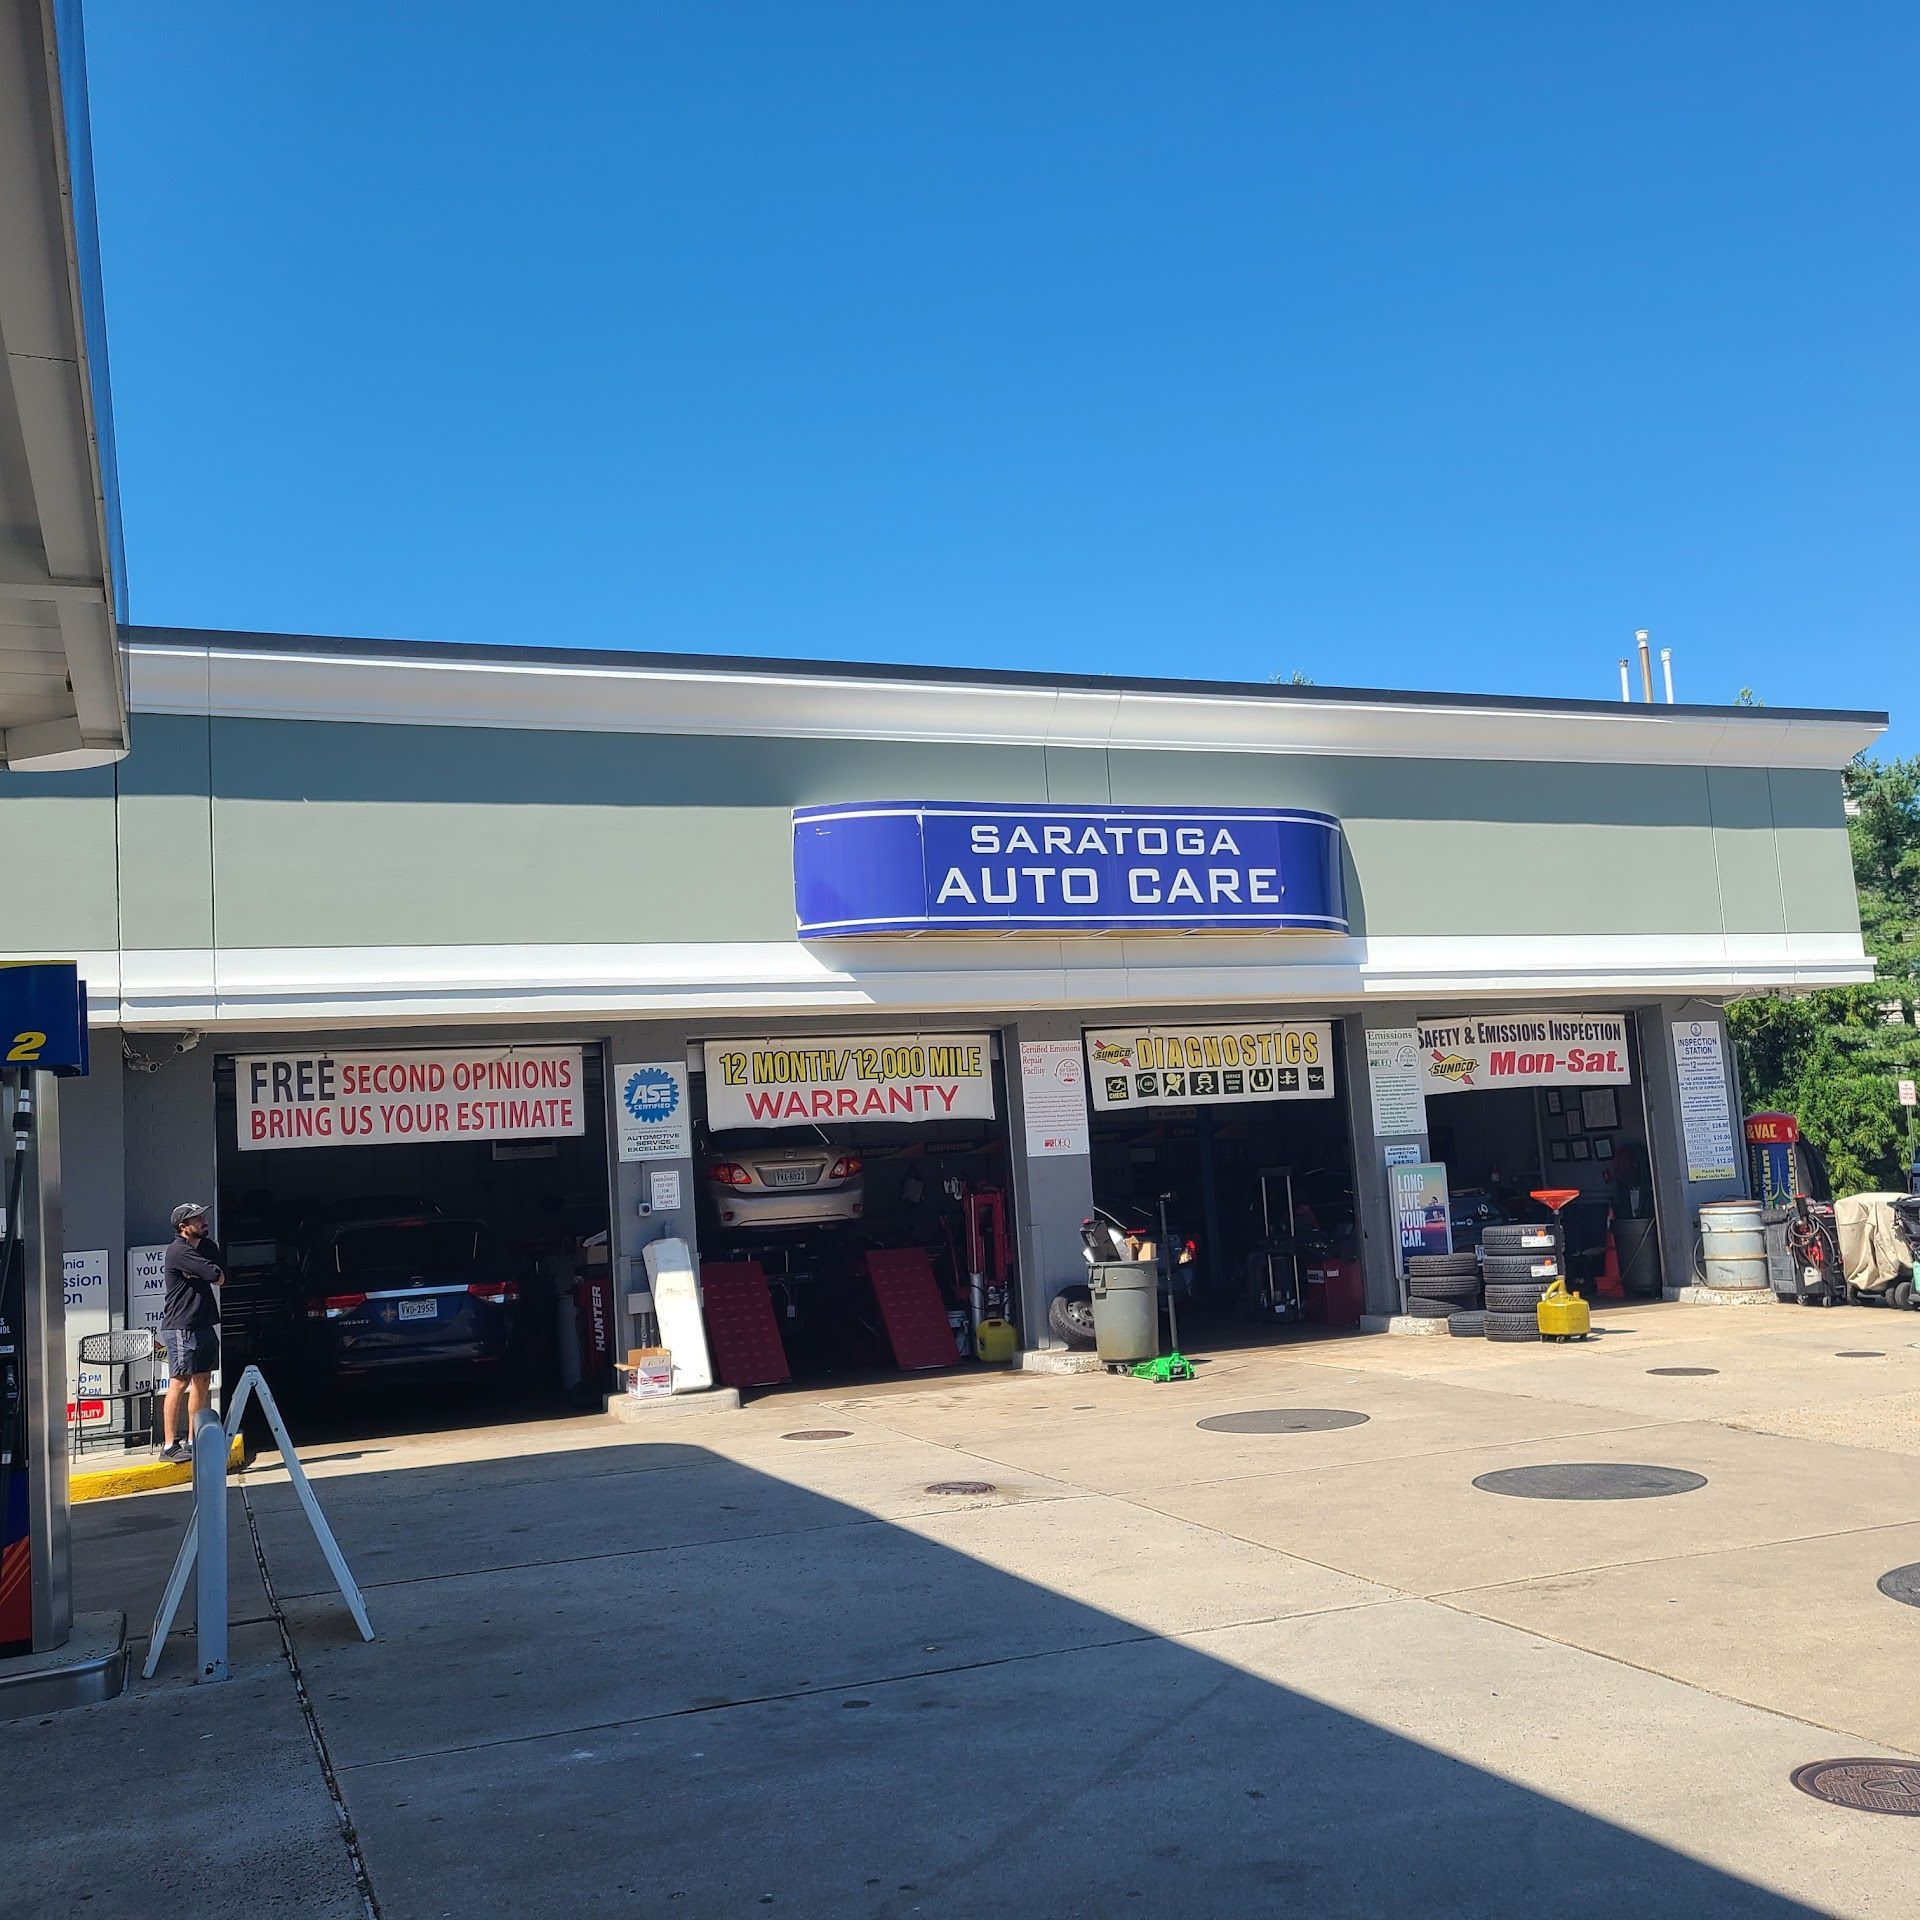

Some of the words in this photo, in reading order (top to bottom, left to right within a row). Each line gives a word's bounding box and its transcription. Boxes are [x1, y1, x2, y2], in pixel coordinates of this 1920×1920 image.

[970, 825, 1240, 856] SARATOGA
[936, 867, 1099, 904] AUTO
[1127, 868, 1280, 903] CARE
[1368, 1031, 1412, 1040] Emissions
[1419, 1027, 1459, 1048] SAFETY
[1464, 1026, 1475, 1044] &
[1477, 1022, 1546, 1043] EMISSIONS
[1549, 1020, 1621, 1042] INSPECTION
[1678, 1038, 1717, 1047] INSPECTION
[6, 1031, 47, 1061] 2
[1021, 1046, 1048, 1054] Certified
[1050, 1044, 1080, 1053] Emissions
[1095, 1049, 1131, 1059] SUNOCO
[1136, 1032, 1318, 1070] DIAGNOSTICS
[1685, 1047, 1712, 1055] STATION
[719, 1052, 747, 1085] 12
[929, 1047, 982, 1077] MILE
[1023, 1056, 1042, 1066] Repair
[1433, 1062, 1474, 1075] SUNOCO
[1490, 1049, 1624, 1076] Mon-Sat.
[1023, 1067, 1045, 1076] Facility
[251, 1060, 336, 1104] FREE
[342, 1063, 445, 1095] SECOND
[453, 1060, 572, 1091] OPINIONS
[631, 1084, 670, 1104] ASE
[745, 1085, 959, 1120] WARRANTY
[1109, 1092, 1127, 1100] CHECK
[251, 1107, 332, 1140] BRING
[340, 1105, 373, 1135] US
[379, 1103, 449, 1133] YOUR
[457, 1099, 573, 1131] ESTIMATE
[627, 1133, 679, 1141] AUTOMOTIVE
[1397, 1174, 1424, 1192] LONG
[1399, 1193, 1420, 1210] LIVE
[1400, 1212, 1426, 1229] YOUR
[1402, 1230, 1425, 1248] CAR.
[63, 1259, 84, 1269] inia
[146, 1252, 163, 1262] WE
[136, 1266, 157, 1276] YOU
[63, 1275, 102, 1287] ssion
[145, 1312, 164, 1321] THA
[592, 1286, 605, 1351] HUNTER
